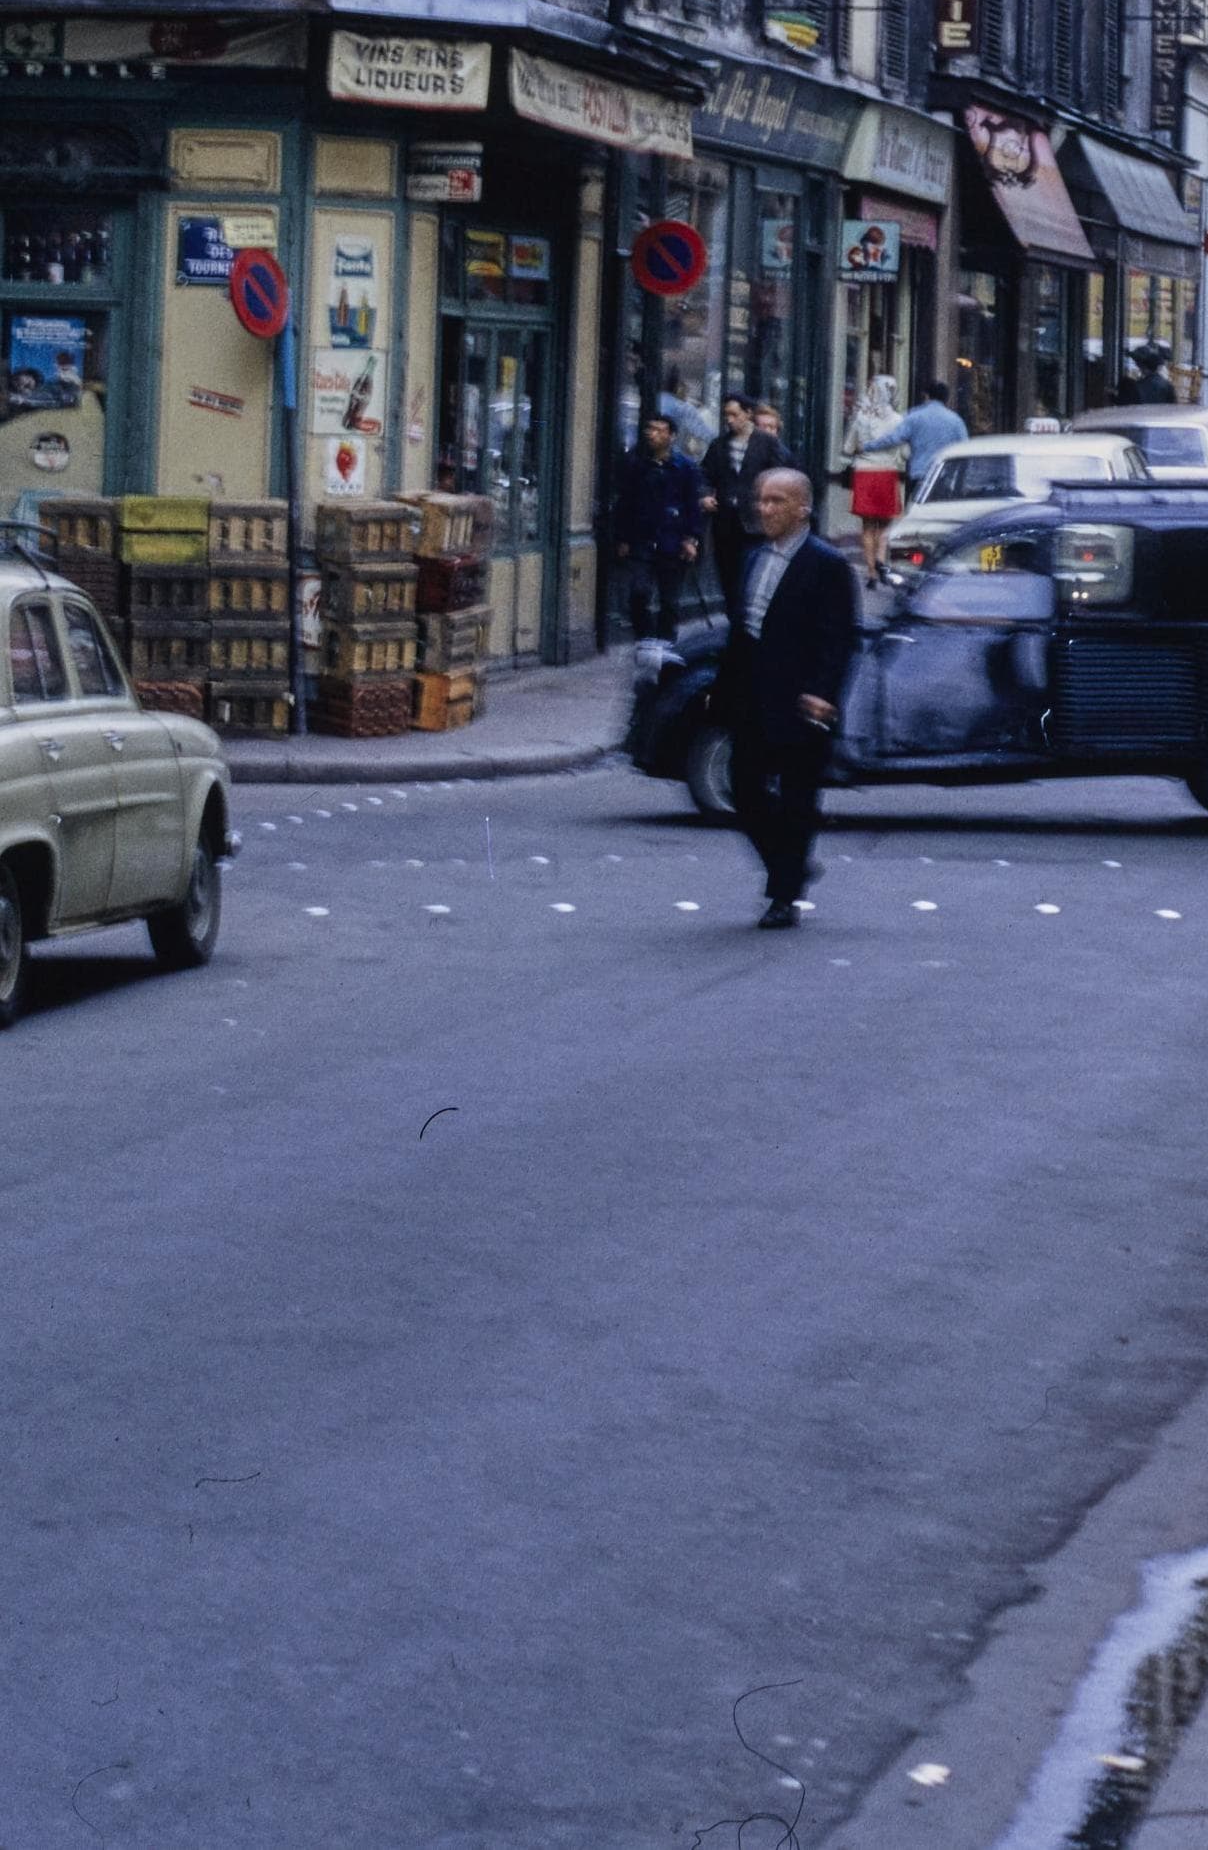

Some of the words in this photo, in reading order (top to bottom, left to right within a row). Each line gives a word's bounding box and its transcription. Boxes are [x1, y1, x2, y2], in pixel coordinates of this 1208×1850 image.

[355, 42, 403, 65] VINS
[415, 45, 464, 69] FINS
[354, 68, 464, 95] LIQUEURS
